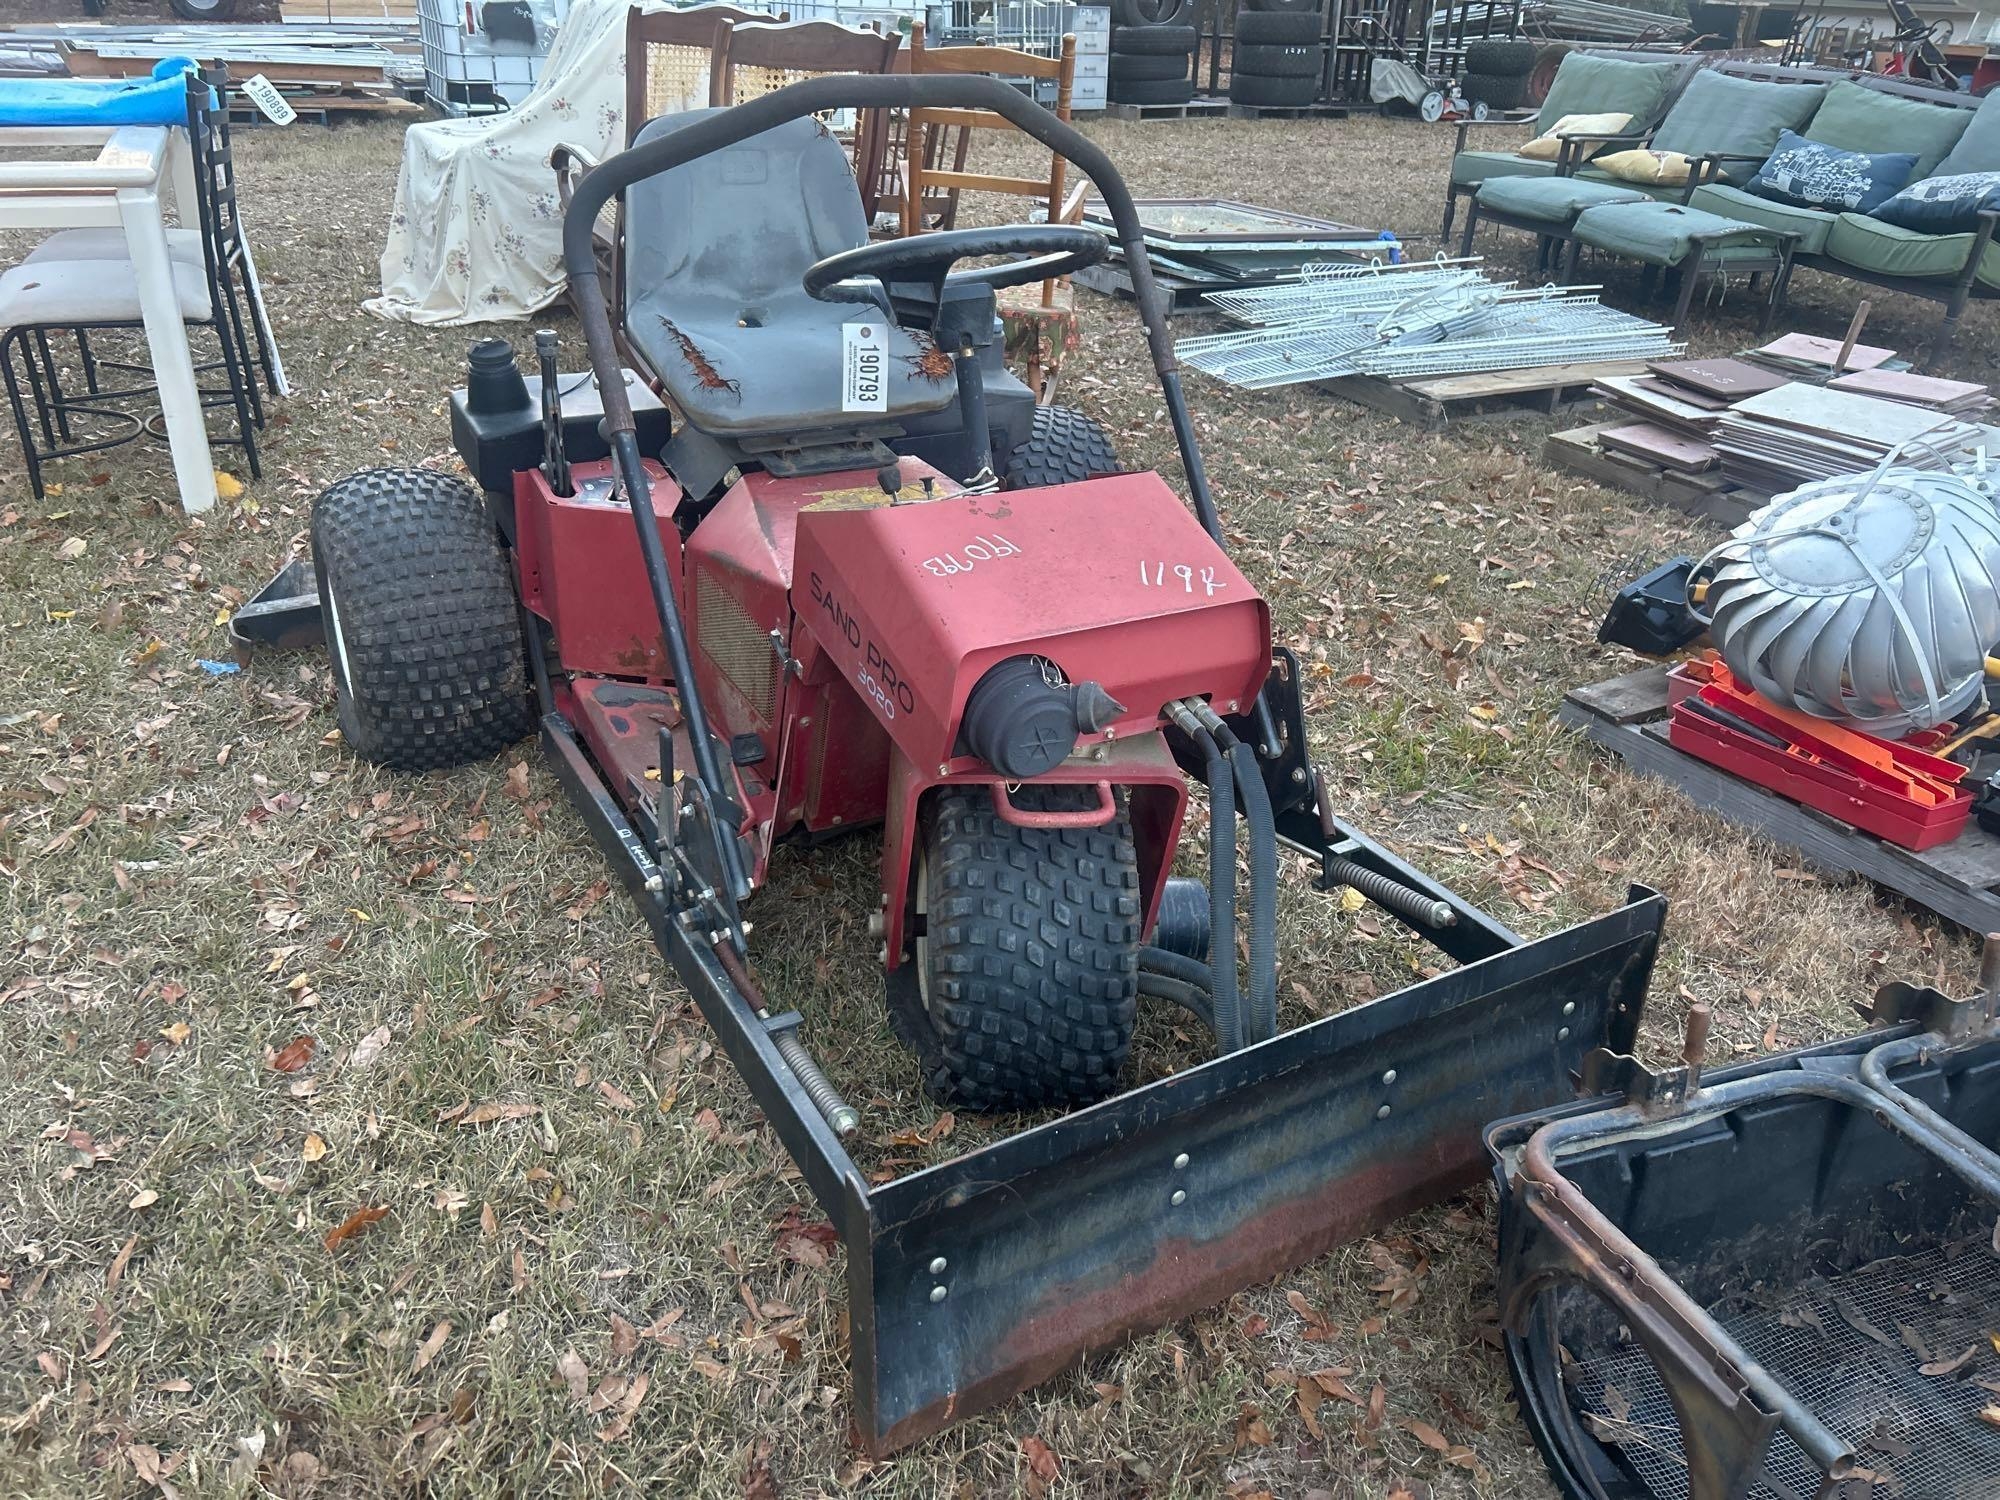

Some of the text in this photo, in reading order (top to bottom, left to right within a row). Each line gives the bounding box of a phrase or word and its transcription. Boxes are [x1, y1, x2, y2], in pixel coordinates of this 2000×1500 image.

[257, 84, 289, 119] 190899
[858, 344, 880, 402] 190793
[923, 533, 1022, 576] 190793
[810, 572, 914, 714] SAND PRO
[858, 661, 894, 719] 3020
